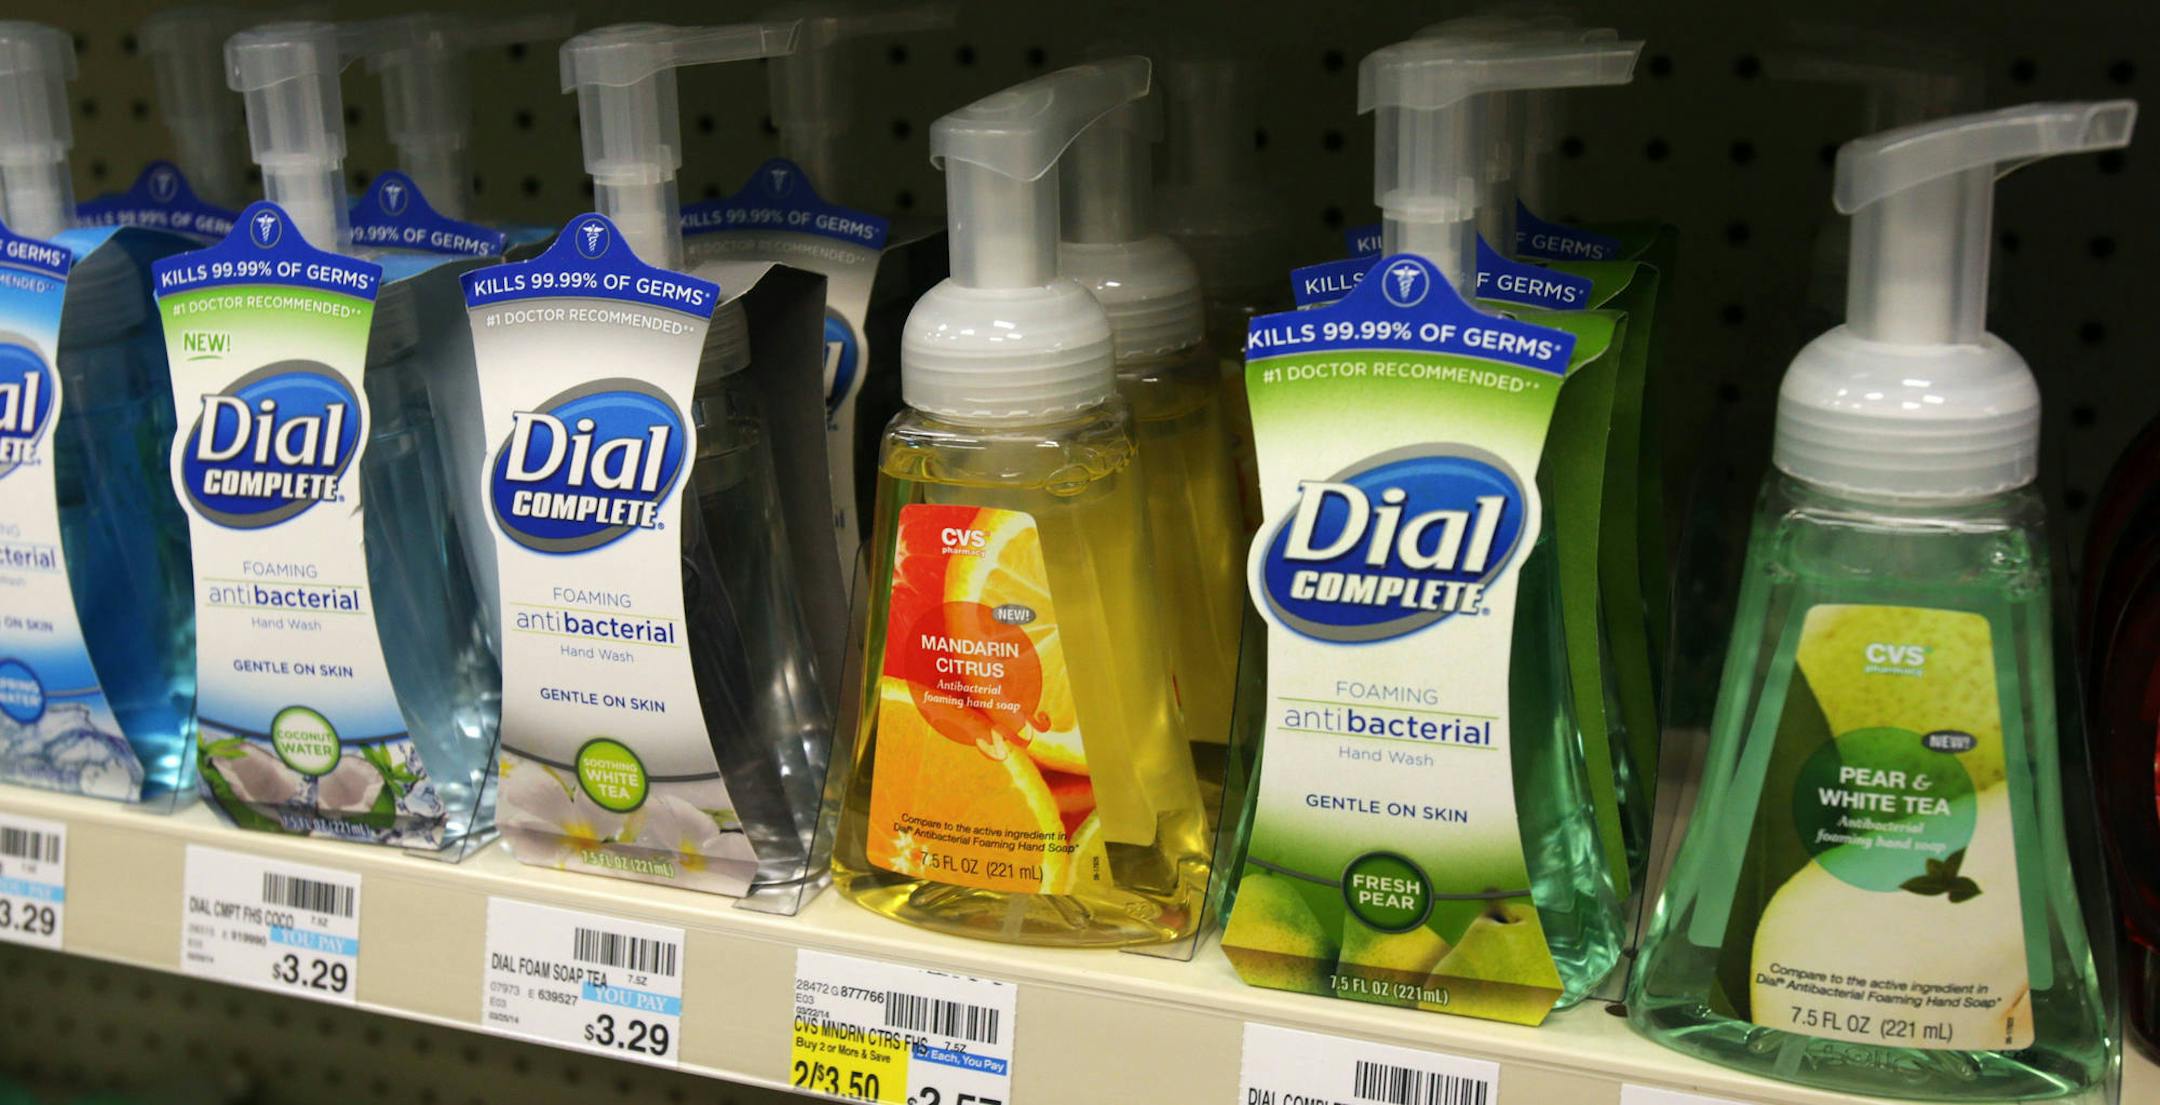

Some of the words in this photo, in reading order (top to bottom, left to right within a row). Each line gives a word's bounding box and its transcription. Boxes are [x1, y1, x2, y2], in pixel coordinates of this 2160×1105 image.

[403, 227, 426, 243] OF
[162, 262, 207, 288] KILLS
[213, 259, 272, 278] 99.99%
[277, 261, 302, 279] OF
[474, 275, 526, 297] KILLS
[531, 271, 598, 290] 99.99%
[603, 274, 632, 291] OF
[190, 296, 242, 313] DOCTOR
[487, 314, 501, 328] #1
[505, 308, 566, 326] DOCTOR
[184, 332, 231, 352] NEW!
[1248, 322, 1317, 350] KILLS
[1323, 320, 1412, 342] 99.99%
[1419, 322, 1456, 343] OF
[1263, 369, 1282, 384] #1
[1288, 361, 1367, 381] DOCTOR
[197, 393, 345, 467] Dial
[505, 411, 672, 493] Dial
[941, 527, 985, 547] CVS
[1283, 480, 1507, 575] Dial
[942, 546, 986, 559] pharmacy
[243, 561, 318, 579] FOAMING
[209, 585, 360, 611] antibacterial
[553, 586, 632, 608] FOAMING
[251, 616, 283, 631] Hand
[289, 617, 322, 632] Wash
[997, 608, 1030, 622] NEW!
[516, 611, 675, 644] antibacterial
[560, 645, 595, 659] Hand
[599, 649, 635, 664] Wash
[921, 634, 1019, 658] MANDARIN
[1865, 642, 1925, 666] CVS
[233, 659, 289, 675] GENTLE
[294, 662, 316, 676] ON
[320, 664, 353, 678] SKIN
[936, 658, 1005, 678] CITRUS
[937, 679, 1001, 695] Antibacterial
[1336, 680, 1439, 706] FOAMING
[540, 687, 599, 706] GENTLE
[603, 695, 626, 709] ON
[631, 698, 666, 713] SKIN
[923, 691, 963, 708] foaming
[966, 694, 993, 708] hand
[996, 701, 1021, 713] soap
[1284, 707, 1491, 746] antibacterial
[281, 742, 334, 756] WATER
[1928, 734, 1972, 749] NEW!
[583, 757, 638, 772] SOOTHING
[1339, 746, 1383, 762] Hand
[1387, 749, 1435, 767] Wash
[587, 769, 639, 787] WHITE
[1840, 766, 1906, 789] PEAR
[1912, 773, 1933, 791] &
[600, 784, 630, 800] TEA
[1818, 788, 1896, 813] WHITE
[1902, 796, 1952, 817] TEA
[1306, 793, 1381, 815] GENTLE
[1387, 802, 1417, 818] ON
[1423, 806, 1468, 824] SKIN
[901, 813, 941, 829] Compare
[944, 822, 954, 831] to
[956, 823, 972, 834] the
[973, 826, 1002, 837] active
[1004, 829, 1055, 842] ingredient
[1057, 831, 1067, 840] in
[1837, 815, 1925, 834] Antibacterial
[914, 828, 970, 846] Antibacterial
[973, 837, 1015, 852] Foaming
[1018, 841, 1045, 853] Hand
[1815, 828, 1873, 850] foaming
[1875, 835, 1912, 850] hand
[1914, 839, 1947, 855] soap
[920, 851, 940, 869] 7.5
[943, 856, 958, 872] FL
[961, 858, 978, 875] OZ
[986, 861, 1014, 879] (221
[1019, 865, 1044, 883] mL)
[1352, 874, 1421, 895] FRESH
[1358, 890, 1415, 910] PEAR
[190, 896, 211, 917] DIAL
[214, 900, 241, 921] CMPT
[243, 905, 263, 926] FHS
[265, 909, 294, 930] COCO
[272, 953, 348, 993] $3.29
[491, 952, 516, 974] DIAL
[519, 957, 550, 979] FOAM
[553, 963, 584, 985] SOAP
[587, 968, 608, 989] TEA
[1770, 962, 1827, 984] Compare
[1830, 973, 1843, 985] to
[1847, 975, 1867, 988] the
[1870, 978, 1908, 991] active
[1911, 980, 1974, 995] ingredient
[1977, 983, 1989, 995] in
[538, 988, 578, 1006] 639527
[796, 978, 829, 994] 28472
[830, 985, 839, 997] G
[840, 985, 885, 1004] 877766
[1330, 974, 1349, 991] 7.5
[1353, 978, 1368, 994] FL
[1372, 981, 1389, 997] OZ
[1787, 979, 1864, 1001] Antibacterial
[1868, 991, 1922, 1008] Foaming
[1925, 995, 1960, 1008] Hand
[593, 985, 633, 1009] YOU
[637, 992, 667, 1012] PAY
[796, 993, 815, 1005] E03
[584, 1014, 670, 1056] $3.29
[794, 1015, 818, 1034] CVS
[821, 1020, 865, 1041] MNDRN
[868, 1028, 900, 1050] CTRS
[904, 1034, 928, 1055] FHS
[1791, 1006, 1818, 1027] 7.5
[1822, 1010, 1841, 1029] FL
[1847, 1014, 1871, 1034] OZ
[1880, 1017, 1916, 1040] (221
[1923, 1022, 1953, 1042] mL)
[795, 1036, 817, 1052] Buy
[820, 1042, 826, 1052] 2
[828, 1045, 837, 1053] or
[838, 1044, 860, 1058] More
[861, 1048, 867, 1059] &
[869, 1050, 891, 1064] Save
[945, 1041, 967, 1054] 7.5Z
[962, 1055, 982, 1068] You
[984, 1059, 1004, 1073] Pay
